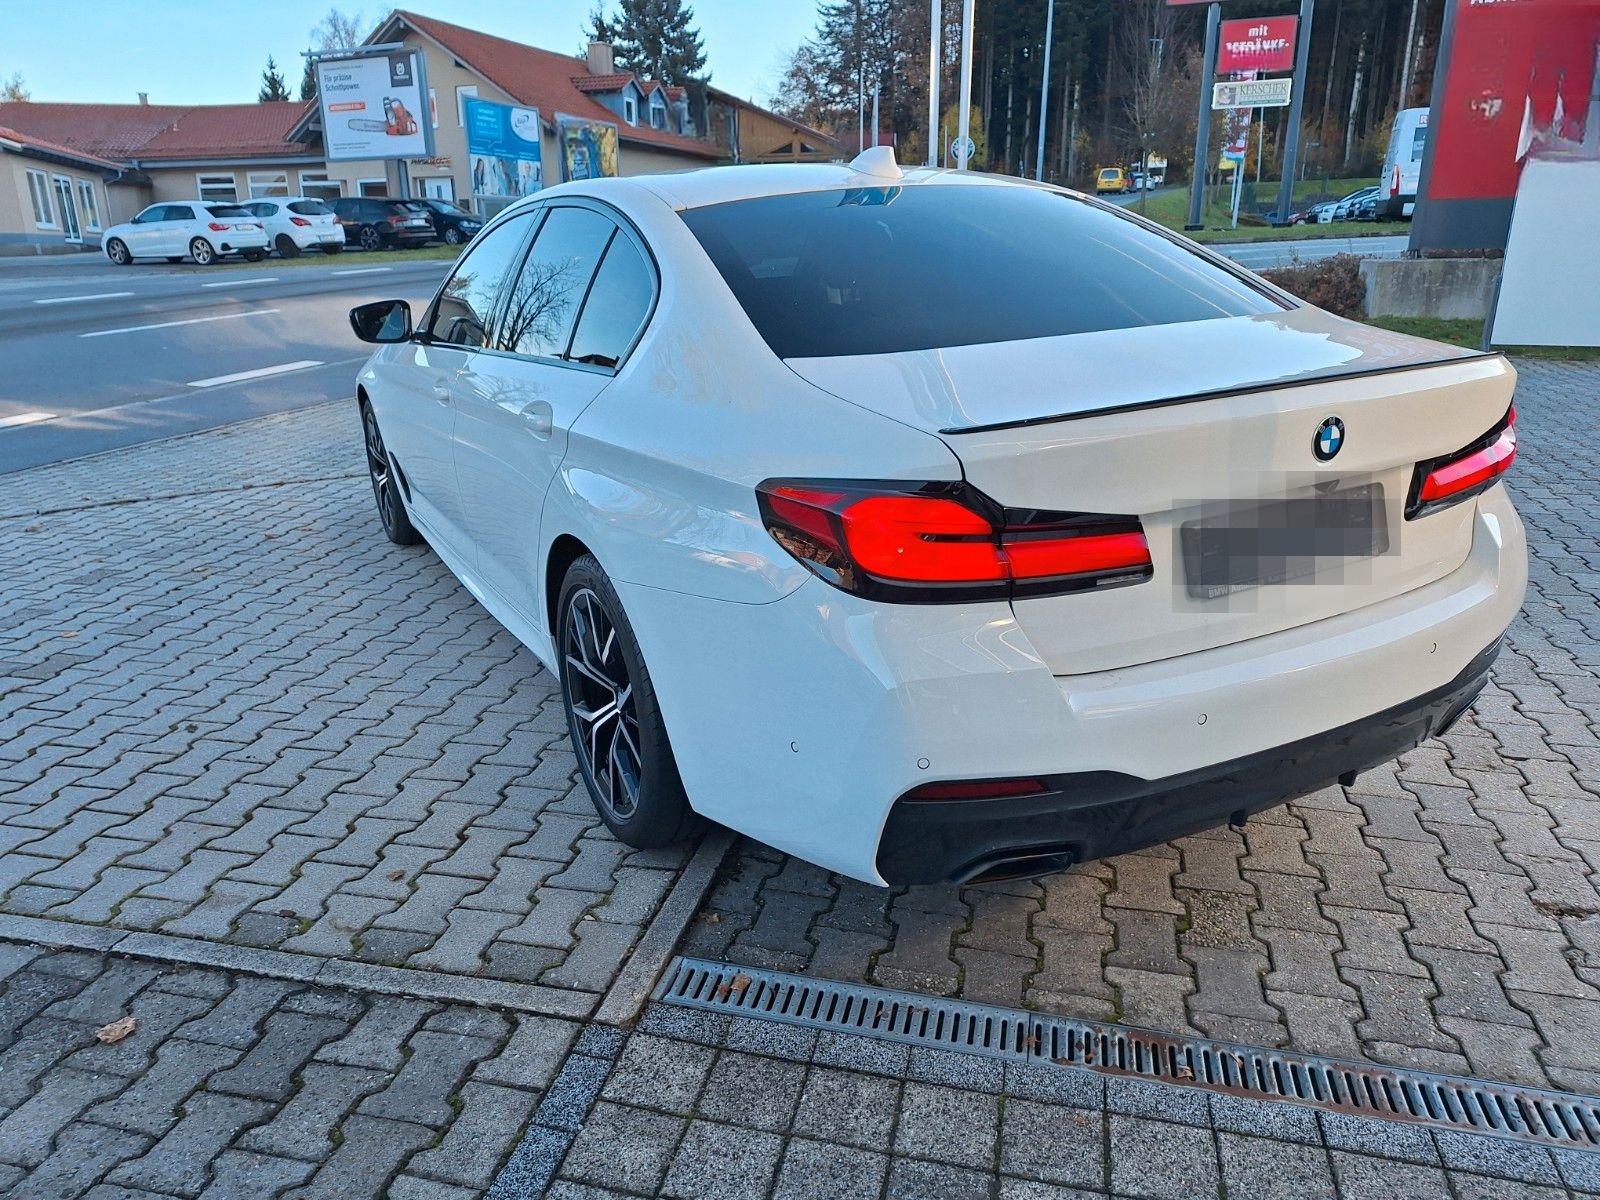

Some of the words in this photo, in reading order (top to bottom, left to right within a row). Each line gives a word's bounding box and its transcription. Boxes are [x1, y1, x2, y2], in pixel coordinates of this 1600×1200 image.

[1248, 24, 1268, 37] mit
[1240, 82, 1288, 97] KERSCHER
[1208, 585, 1228, 598] BMW
